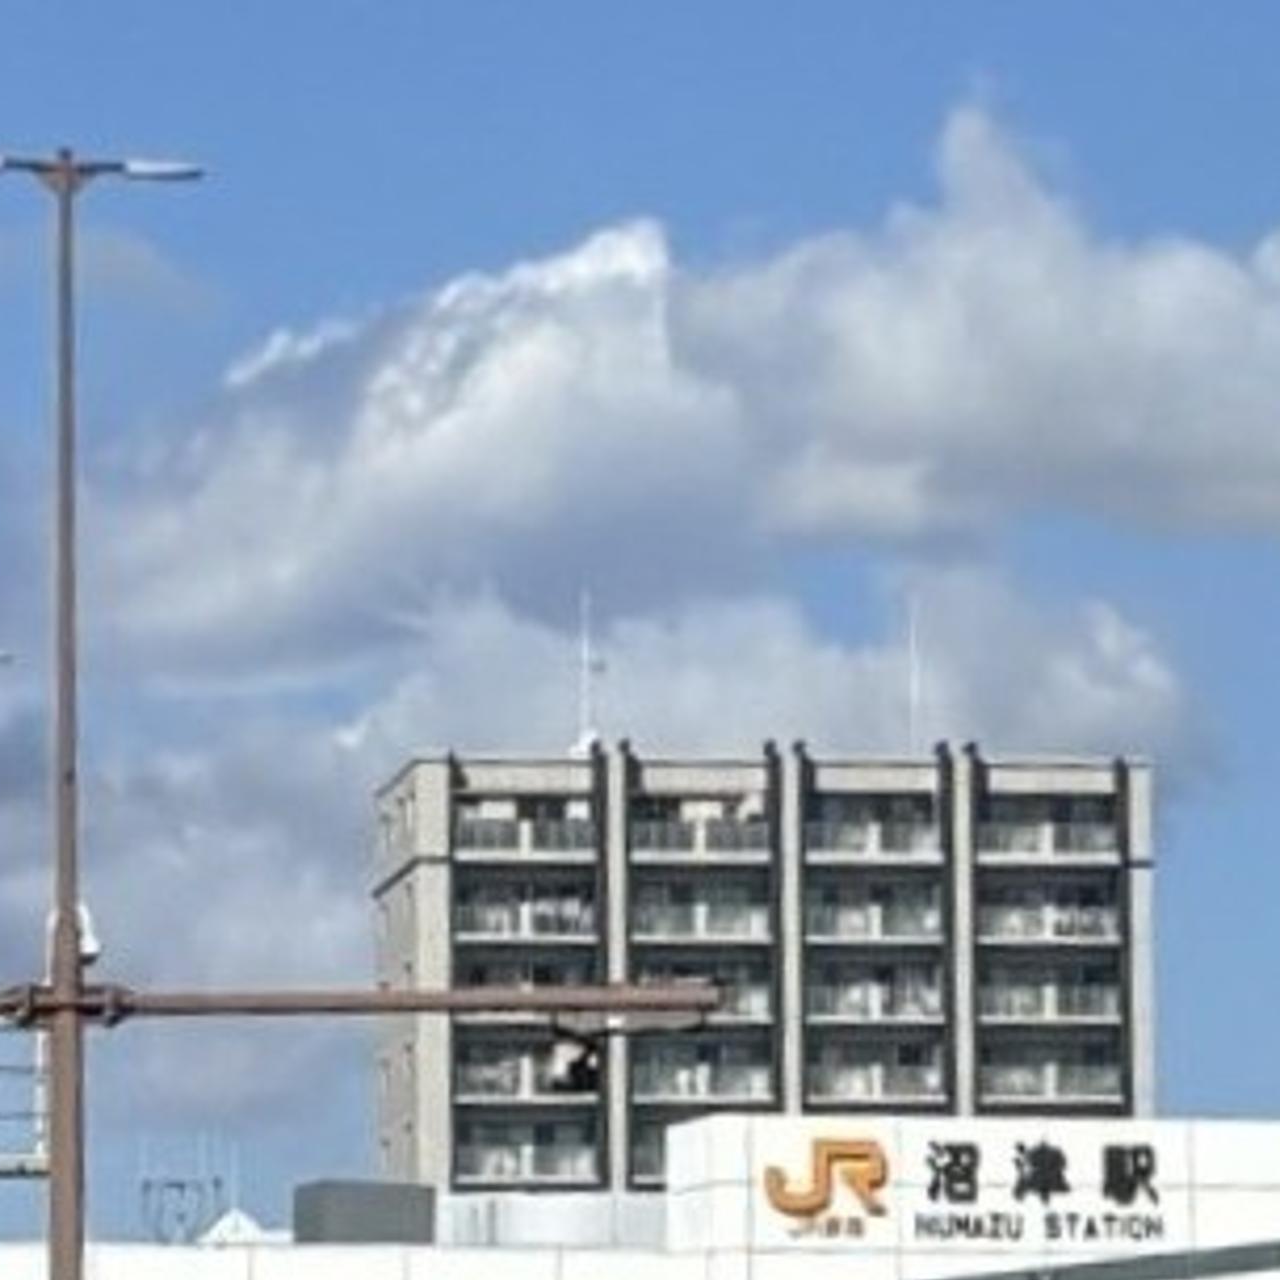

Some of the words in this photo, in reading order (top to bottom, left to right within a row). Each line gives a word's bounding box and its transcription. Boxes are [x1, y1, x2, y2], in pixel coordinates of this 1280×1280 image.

[765, 1137, 889, 1219] JR
[926, 1140, 1161, 1206] 沼津駅
[914, 1212, 1024, 1240] NUMAZU
[1043, 1212, 1164, 1240] STATION
